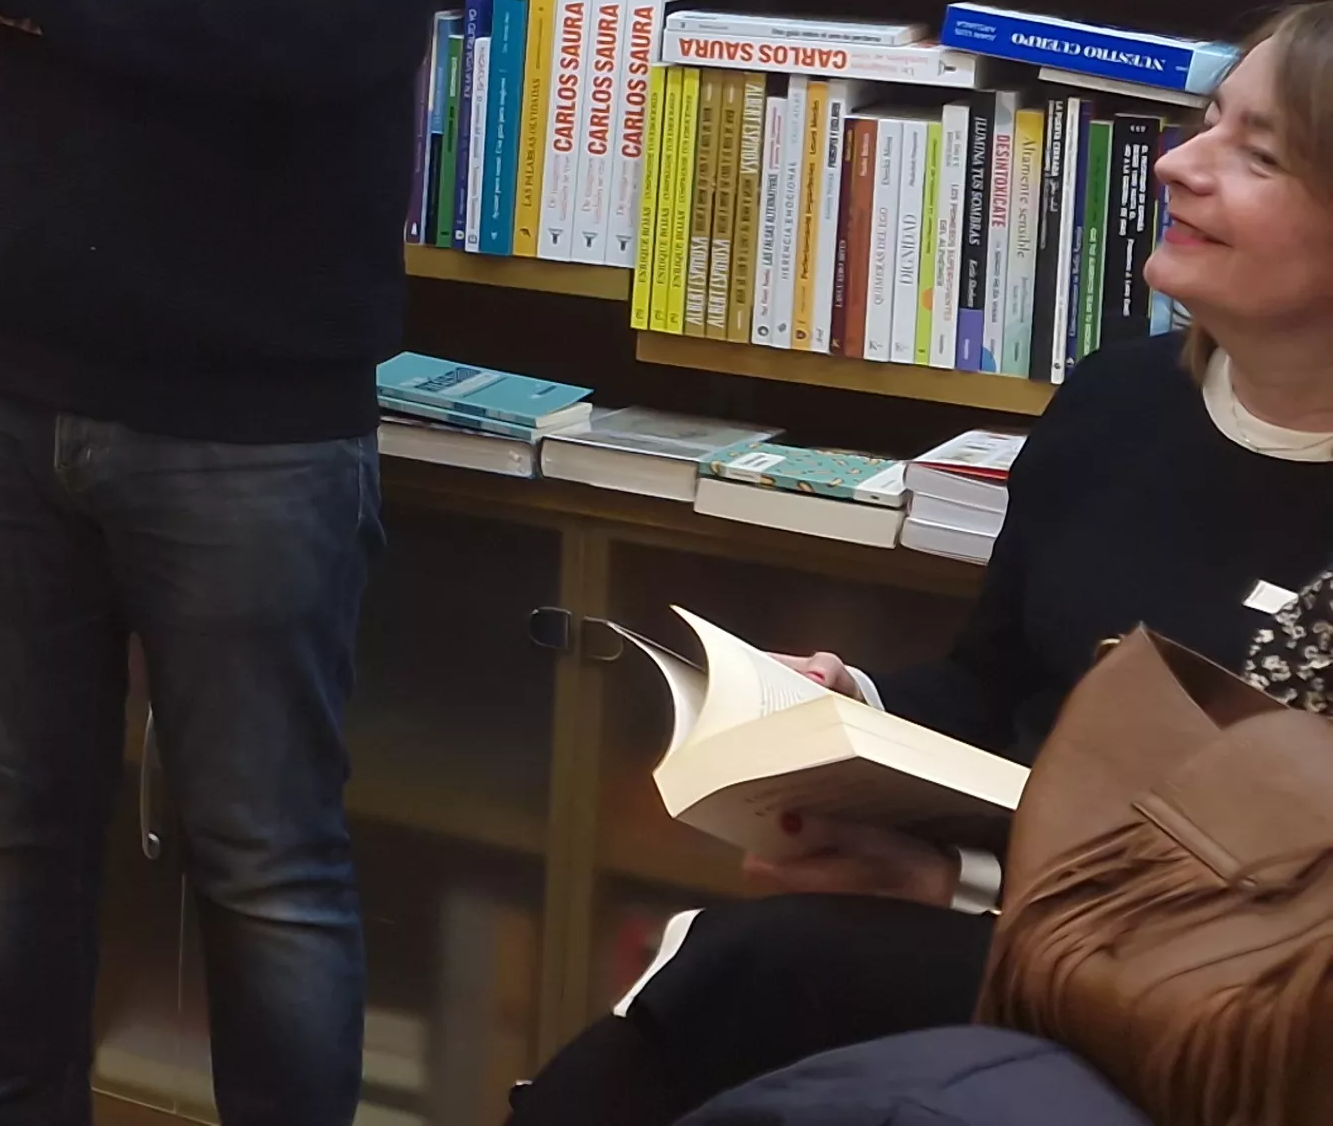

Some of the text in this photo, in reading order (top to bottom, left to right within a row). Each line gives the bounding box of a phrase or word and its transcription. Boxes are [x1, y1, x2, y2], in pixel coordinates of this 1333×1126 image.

[553, 1, 585, 152] CARLOS SAURA
[587, 3, 619, 155] CARLOS SAURA
[621, 5, 654, 158] CARLOS SAURA
[678, 37, 848, 70] CARLOS SAURA
[1010, 30, 1167, 71] NUESTRO CUERPO
[740, 82, 763, 174] ALBERT ESPINOSA
[1054, 101, 1064, 110] LA
[781, 161, 797, 280] HERENCIA EMOCIONAL
[968, 116, 989, 245] ILUMINA TUS SOMBRAS
[991, 133, 1011, 228] DESINTOXICATE
[1016, 136, 1036, 259] Altamente sensible
[637, 206, 652, 283] ENRIQUE ROJAS
[656, 206, 670, 285] ENRIQUE ROJAS
[671, 241, 684, 288] ENRIQUE
[685, 236, 709, 325] ALBERT ESPINOSA
[763, 251, 774, 266] LAS
[764, 224, 776, 251] FALSAS
[873, 207, 889, 306] QUIMERAS DEL EGO
[898, 213, 918, 285] DIGNIDAD
[707, 238, 731, 328] ALBERT ESPINOSA
